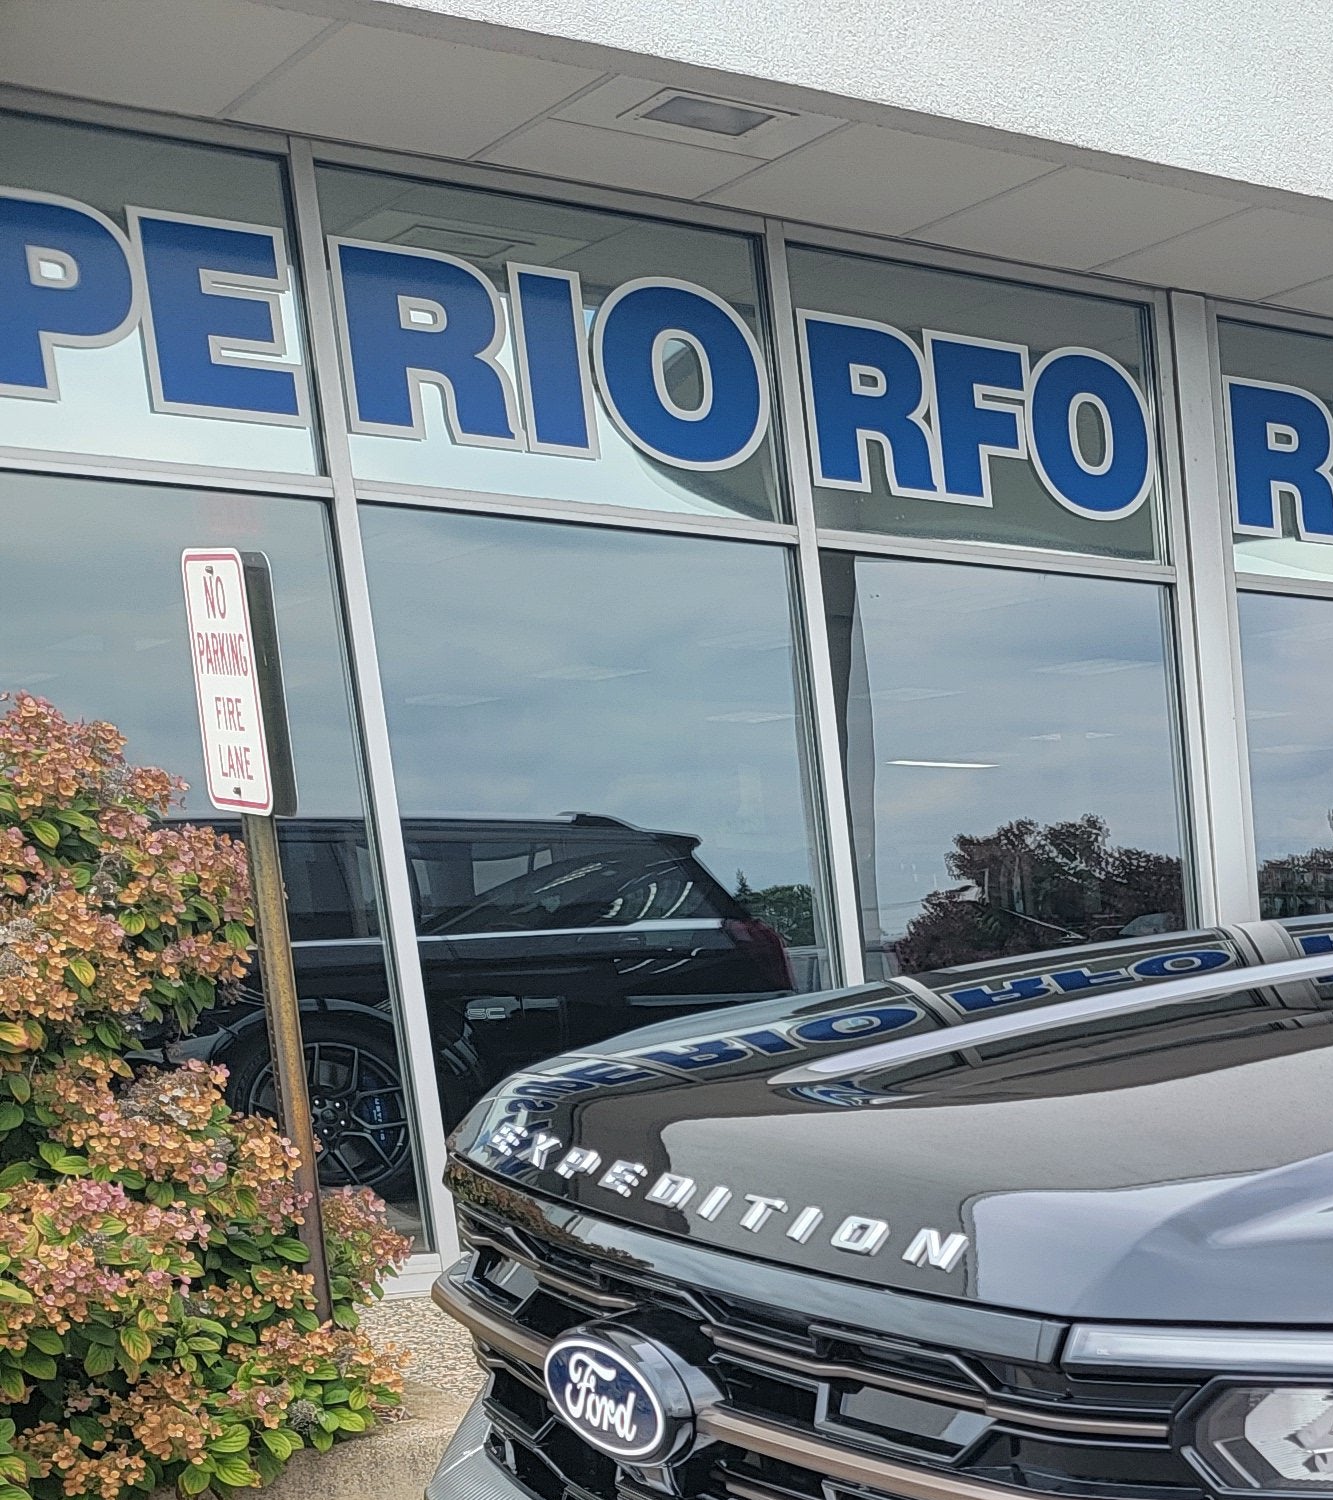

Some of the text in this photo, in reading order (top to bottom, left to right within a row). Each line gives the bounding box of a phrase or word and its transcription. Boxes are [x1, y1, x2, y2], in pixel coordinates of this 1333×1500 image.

[203, 576, 226, 619] NO
[197, 632, 249, 676] PARKING
[215, 696, 245, 731] FIRE
[218, 744, 253, 780] LANE
[486, 1122, 970, 1273] EXPEDITION
[565, 1352, 637, 1442] Ford
